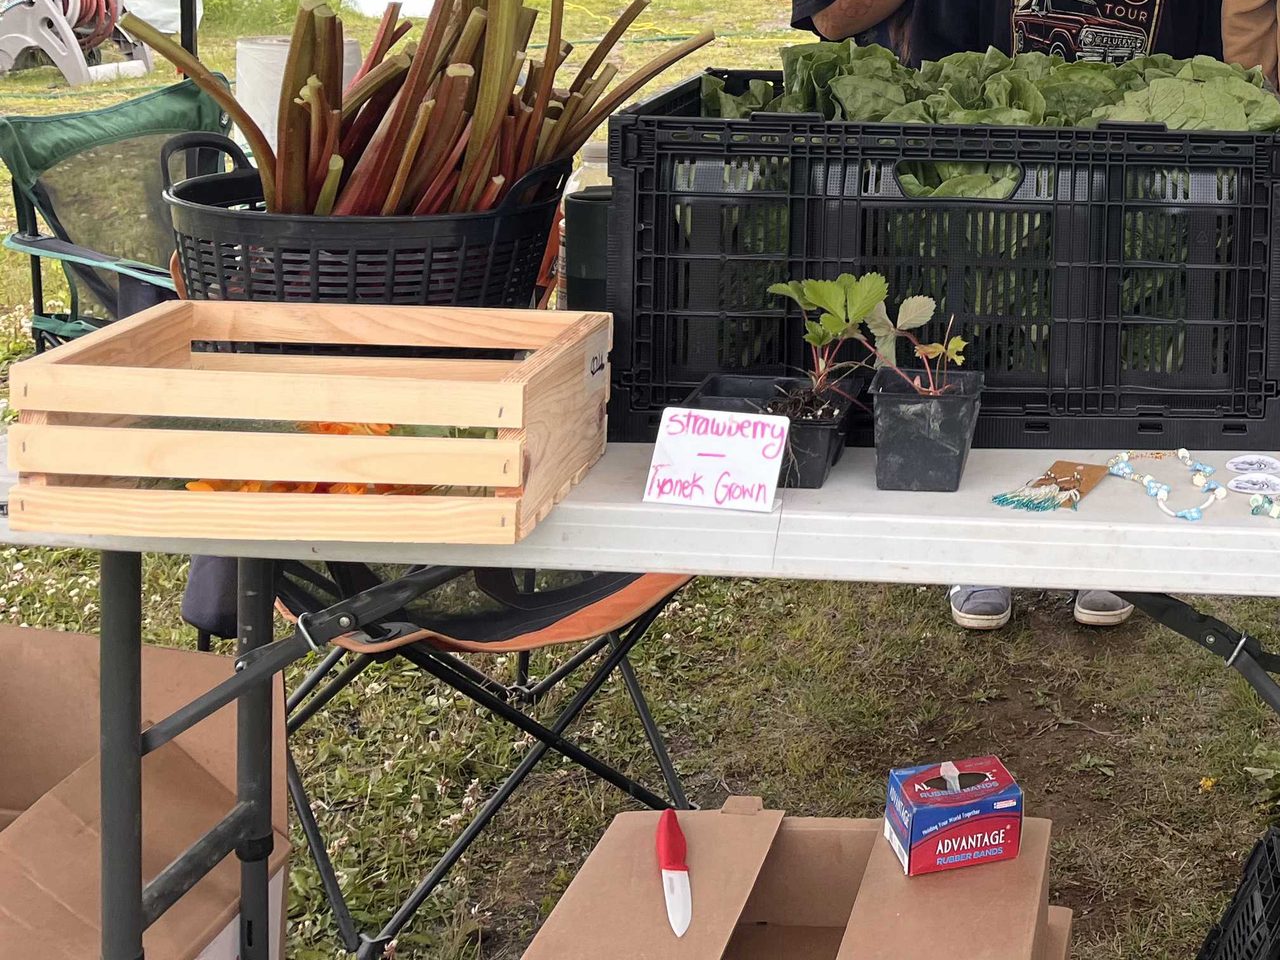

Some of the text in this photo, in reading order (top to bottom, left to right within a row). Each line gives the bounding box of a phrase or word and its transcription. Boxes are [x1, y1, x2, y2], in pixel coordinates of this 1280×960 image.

[1105, 3, 1148, 22] TOUR
[714, 471, 767, 505] Grown
[936, 829, 1005, 855] ADVANTAGE
[936, 846, 1004, 865] RUBBER BANDS
